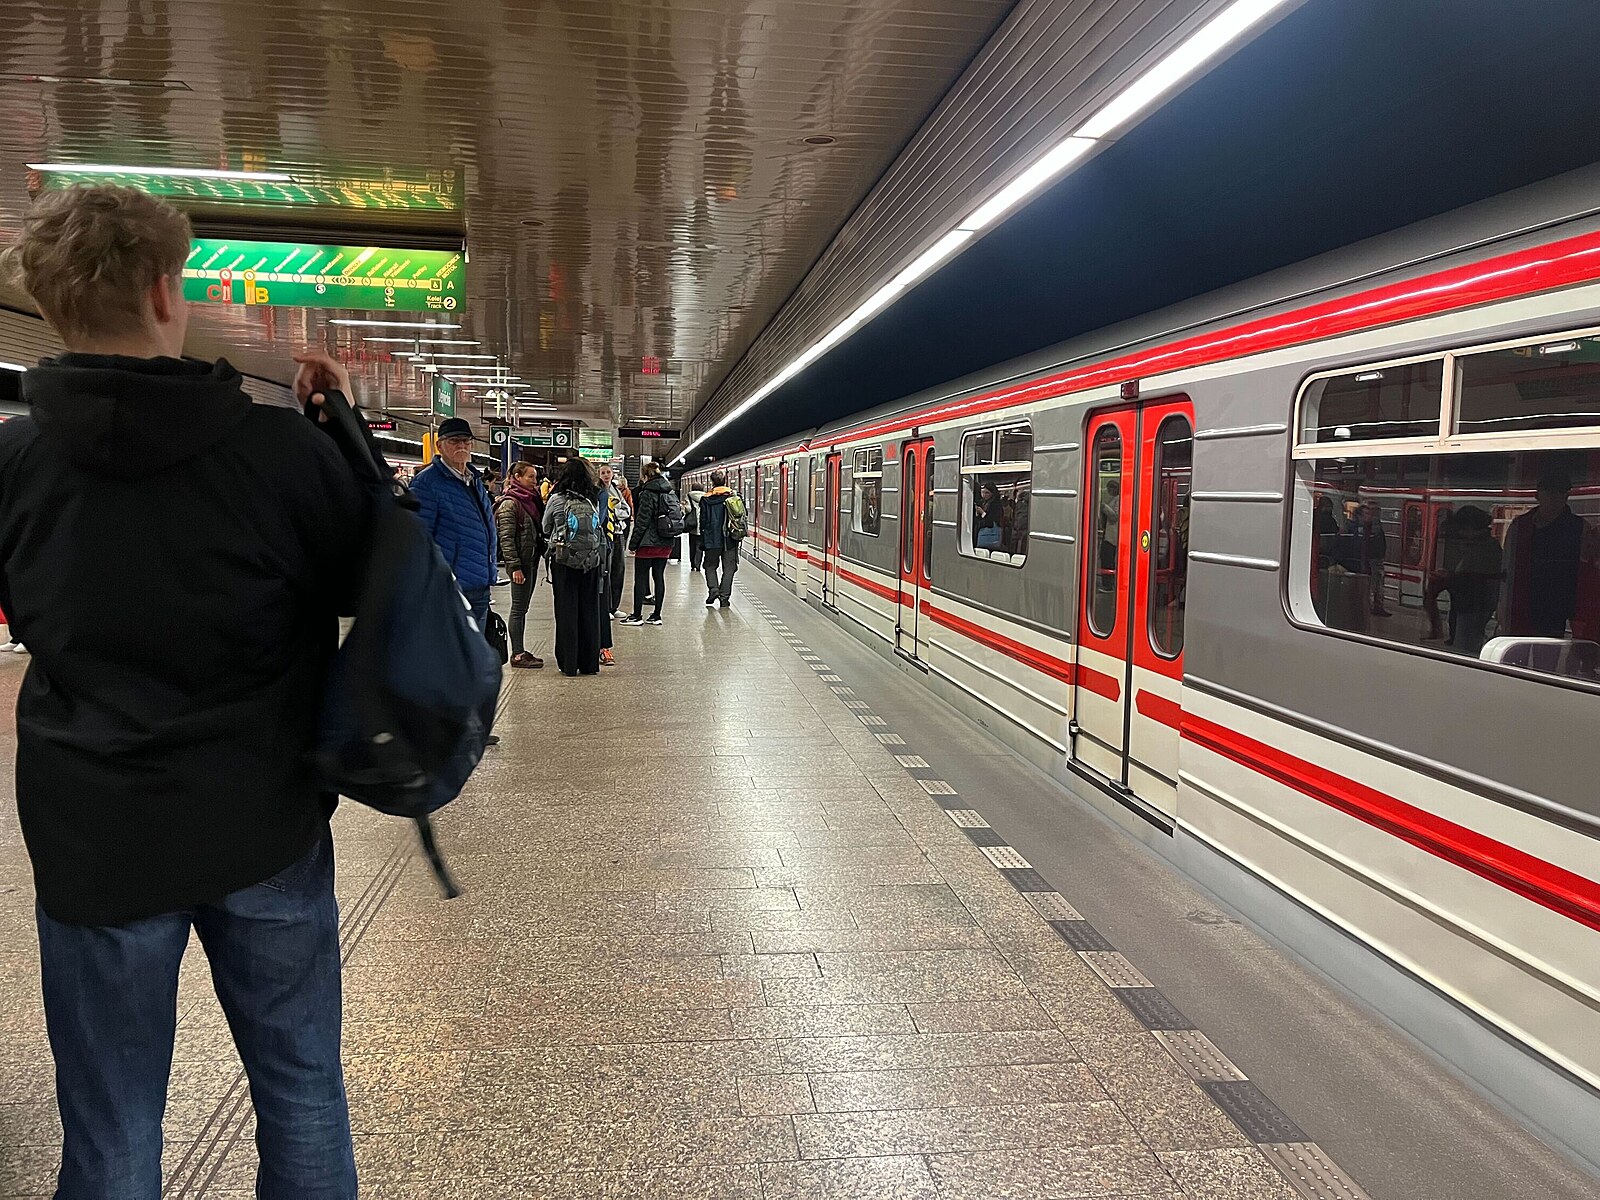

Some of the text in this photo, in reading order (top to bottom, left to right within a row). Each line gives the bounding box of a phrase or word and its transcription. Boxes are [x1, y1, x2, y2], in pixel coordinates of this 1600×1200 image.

[446, 281, 455, 290] A
[207, 284, 221, 301] C
[255, 287, 269, 303] B
[426, 295, 442, 303] Kolej
[446, 298, 454, 308] 2
